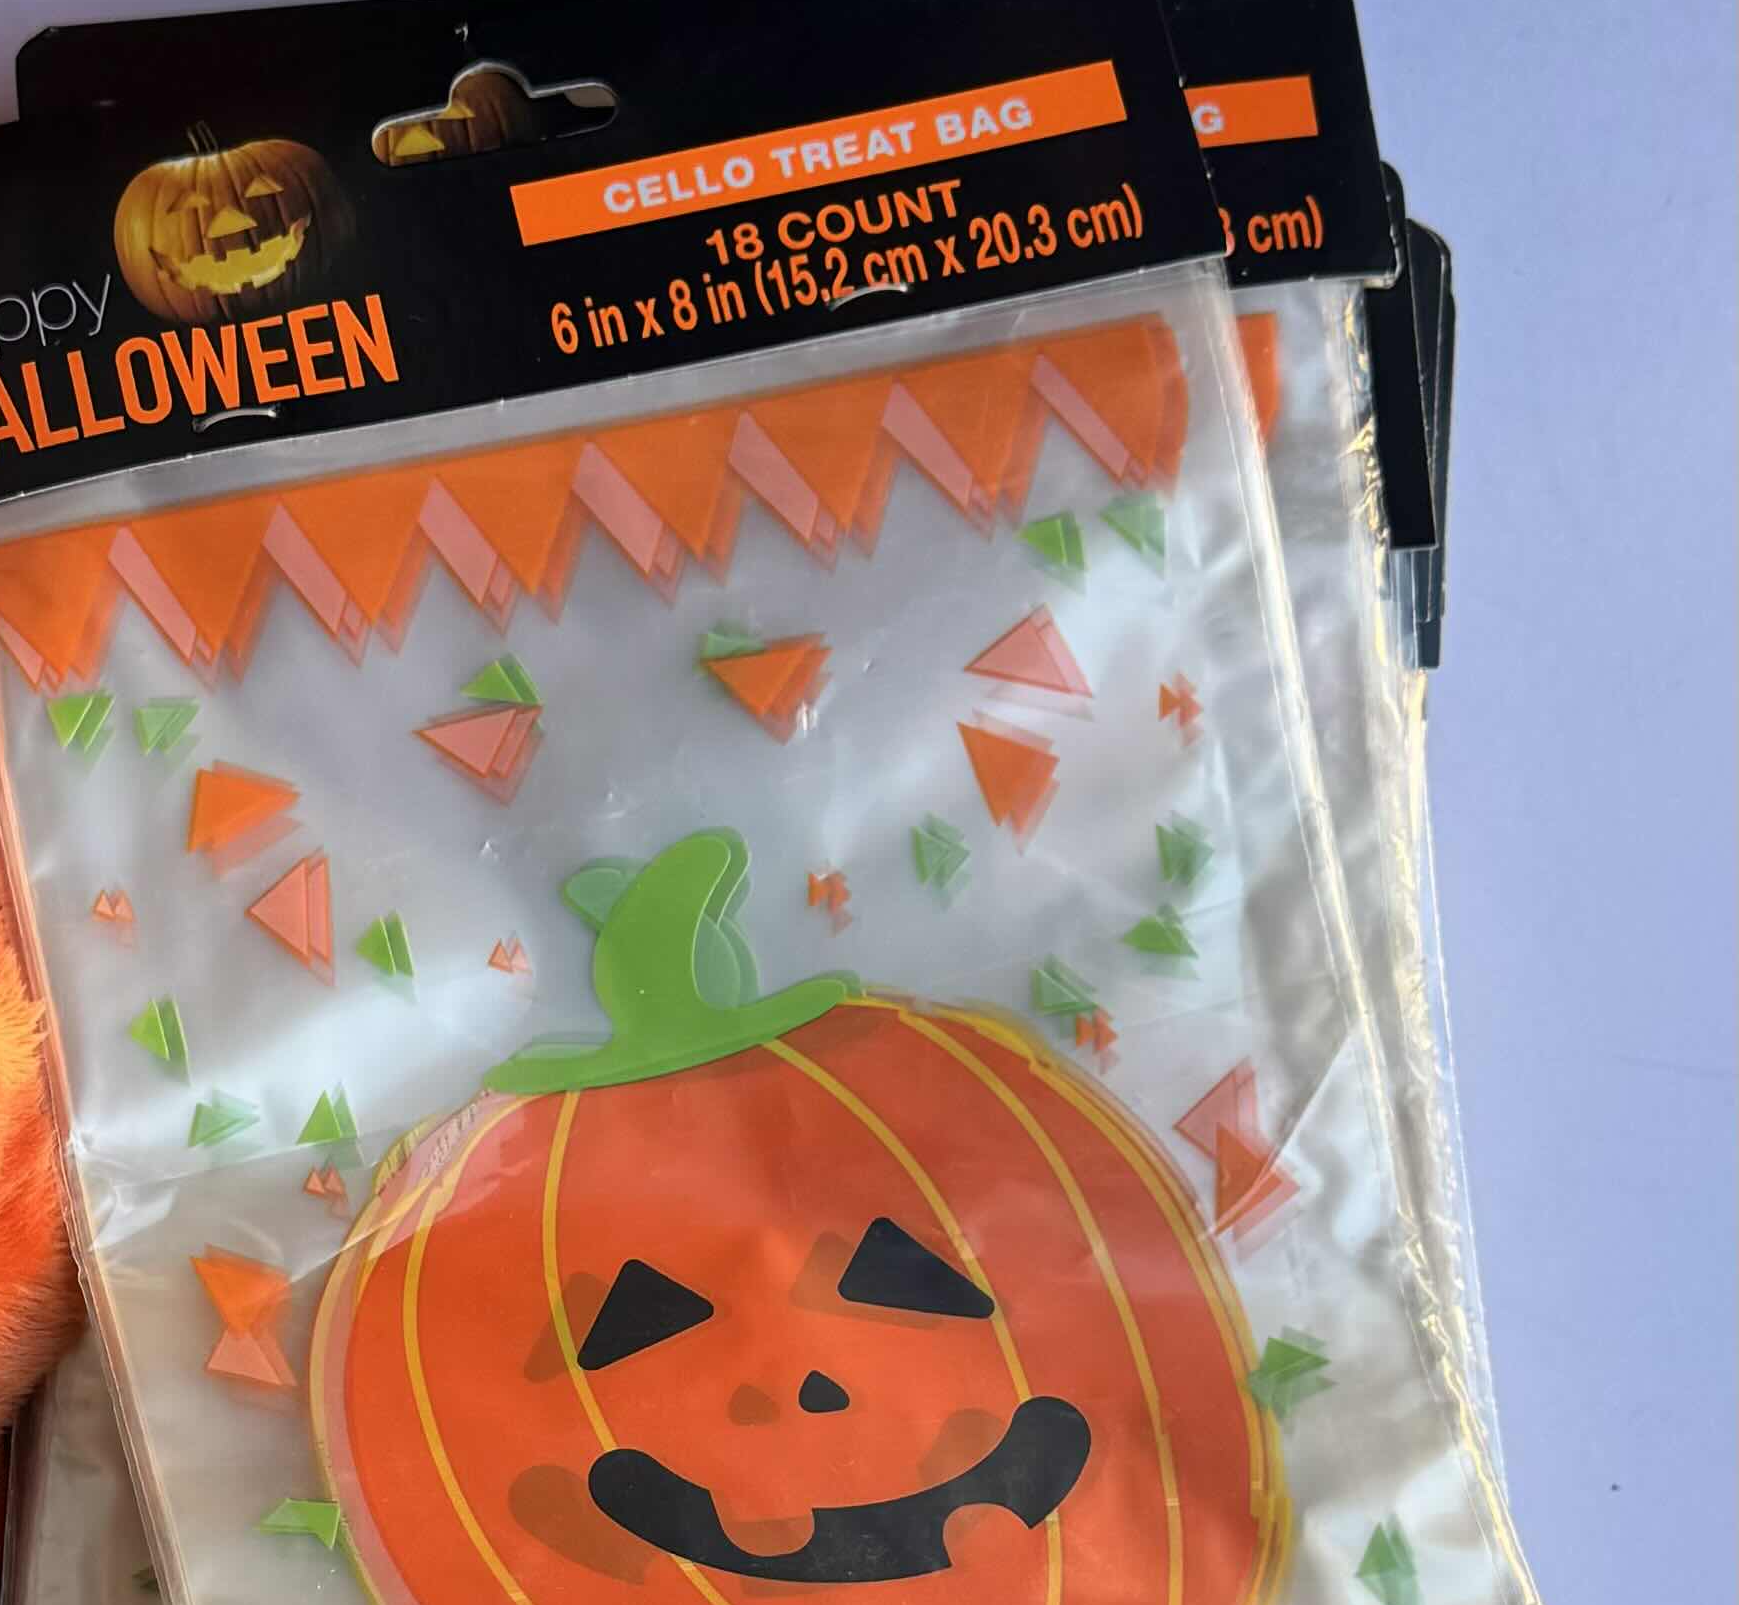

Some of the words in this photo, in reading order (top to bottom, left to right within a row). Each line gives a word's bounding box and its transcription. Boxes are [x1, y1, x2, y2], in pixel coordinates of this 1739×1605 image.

[603, 156, 755, 214] CELLO
[770, 122, 917, 178] TREAT
[934, 97, 1033, 145] BAG
[550, 302, 579, 354] 6
[583, 296, 628, 348] in
[639, 299, 666, 339] x
[668, 278, 698, 332] 8
[702, 272, 747, 326] in
[753, 247, 855, 317] (15.2
[862, 246, 929, 292] cm
[940, 239, 966, 276] x
[970, 203, 1059, 270] 20.3
[1067, 182, 1144, 250] cm)
[706, 223, 764, 266] 18
[778, 179, 962, 252] COUNT
[1247, 194, 1324, 254] cm)
